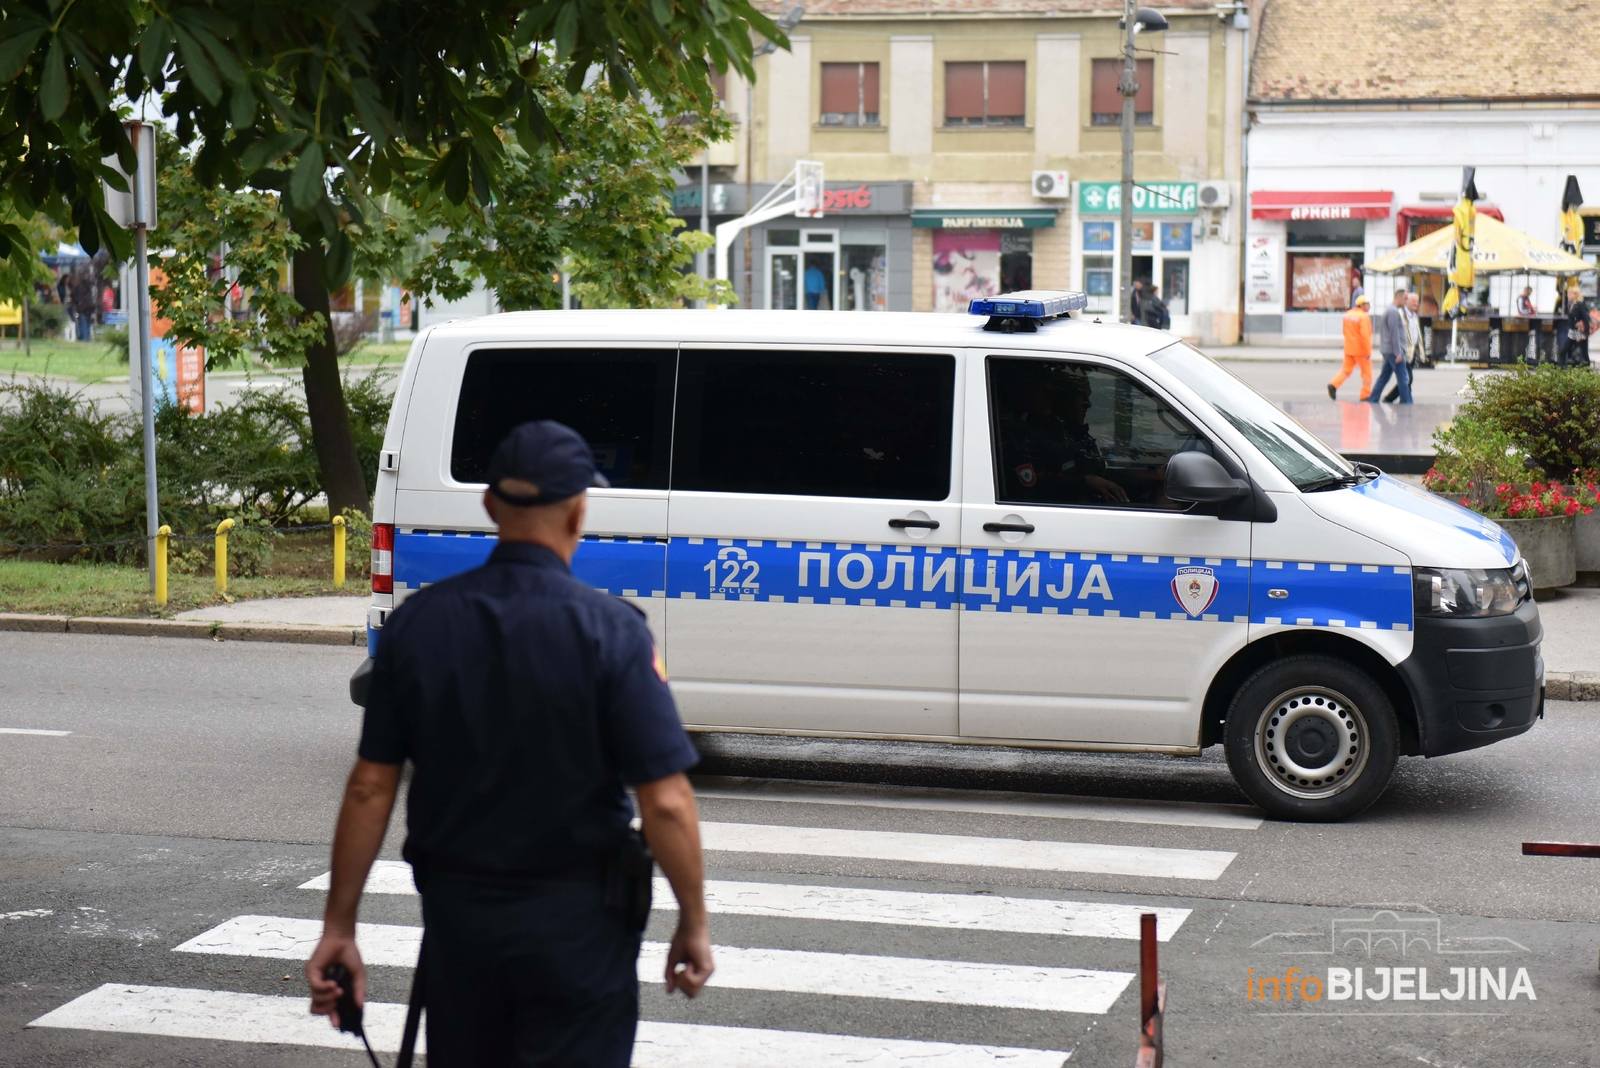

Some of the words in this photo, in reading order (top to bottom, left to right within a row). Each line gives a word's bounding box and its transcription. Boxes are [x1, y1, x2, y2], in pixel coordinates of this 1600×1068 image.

[1107, 184, 1195, 210] AOTEKA
[942, 217, 1024, 228] PARFIMERIJA
[703, 559, 760, 588] 122
[798, 551, 1114, 603] ПОЛИЦИЈА
[709, 587, 760, 595] POLICE
